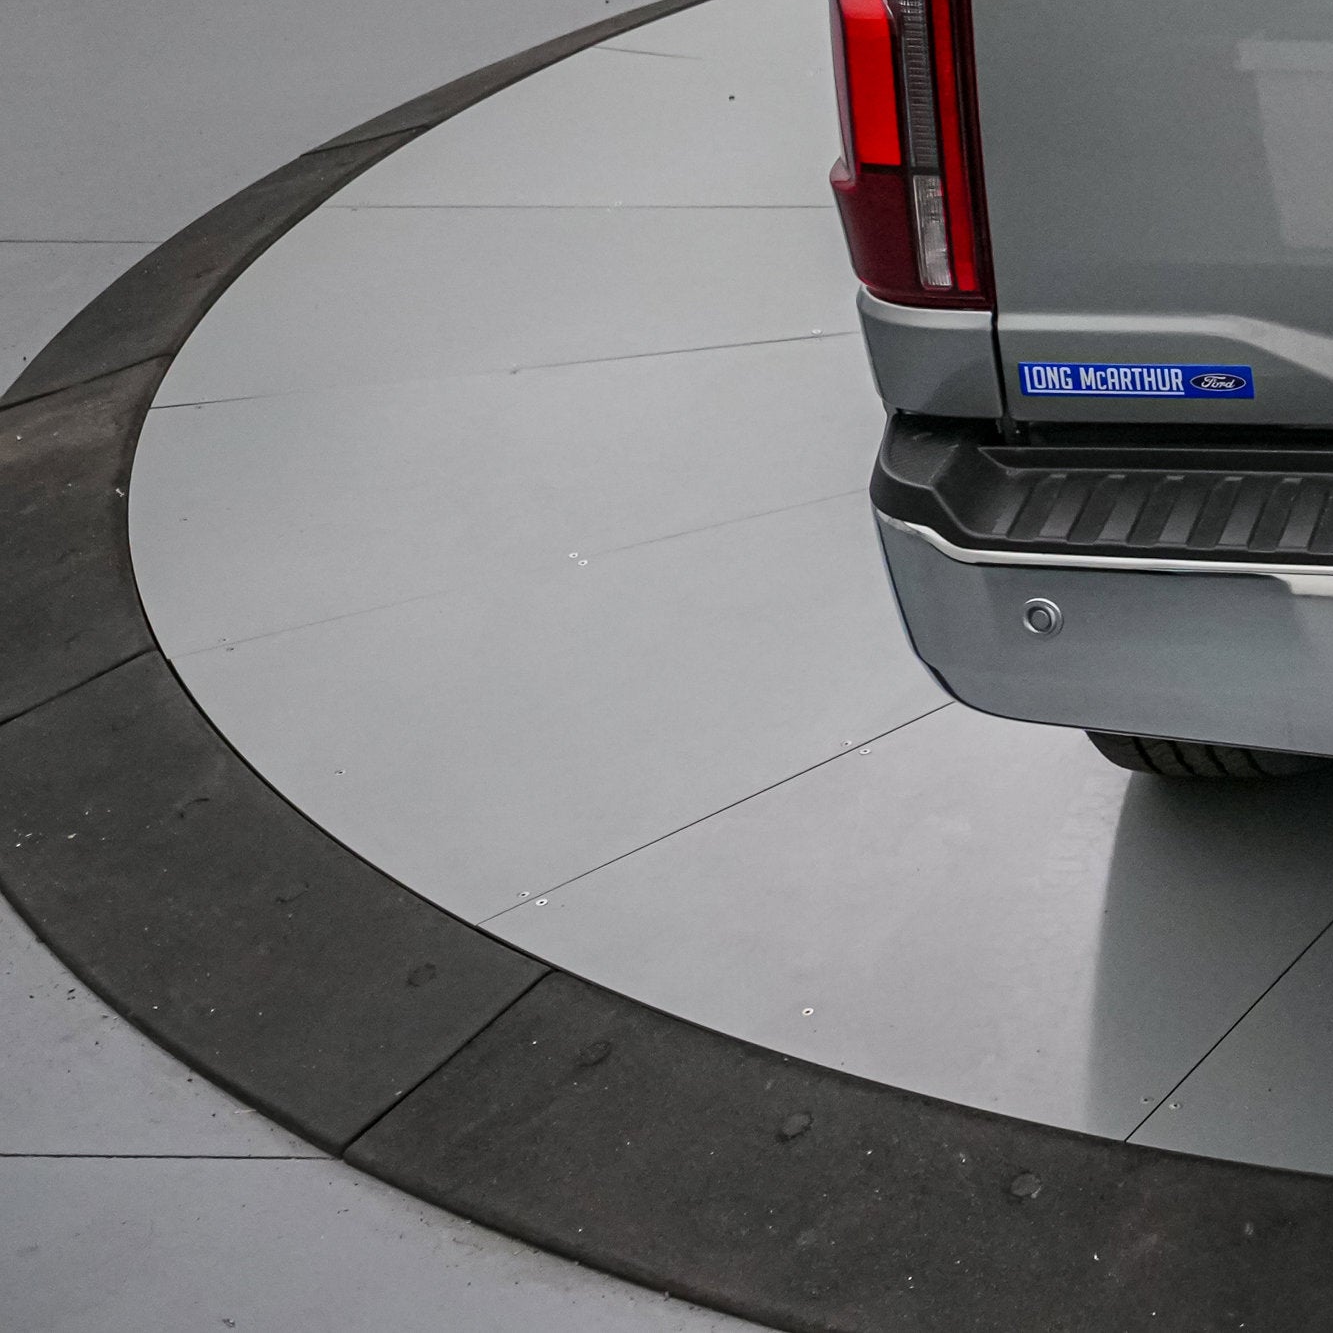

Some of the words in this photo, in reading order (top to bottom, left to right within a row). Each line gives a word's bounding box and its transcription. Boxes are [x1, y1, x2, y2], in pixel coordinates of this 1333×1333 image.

[1023, 365, 1073, 392] LONG
[1079, 367, 1185, 391] McARTHUR
[1201, 373, 1236, 388] Ford
